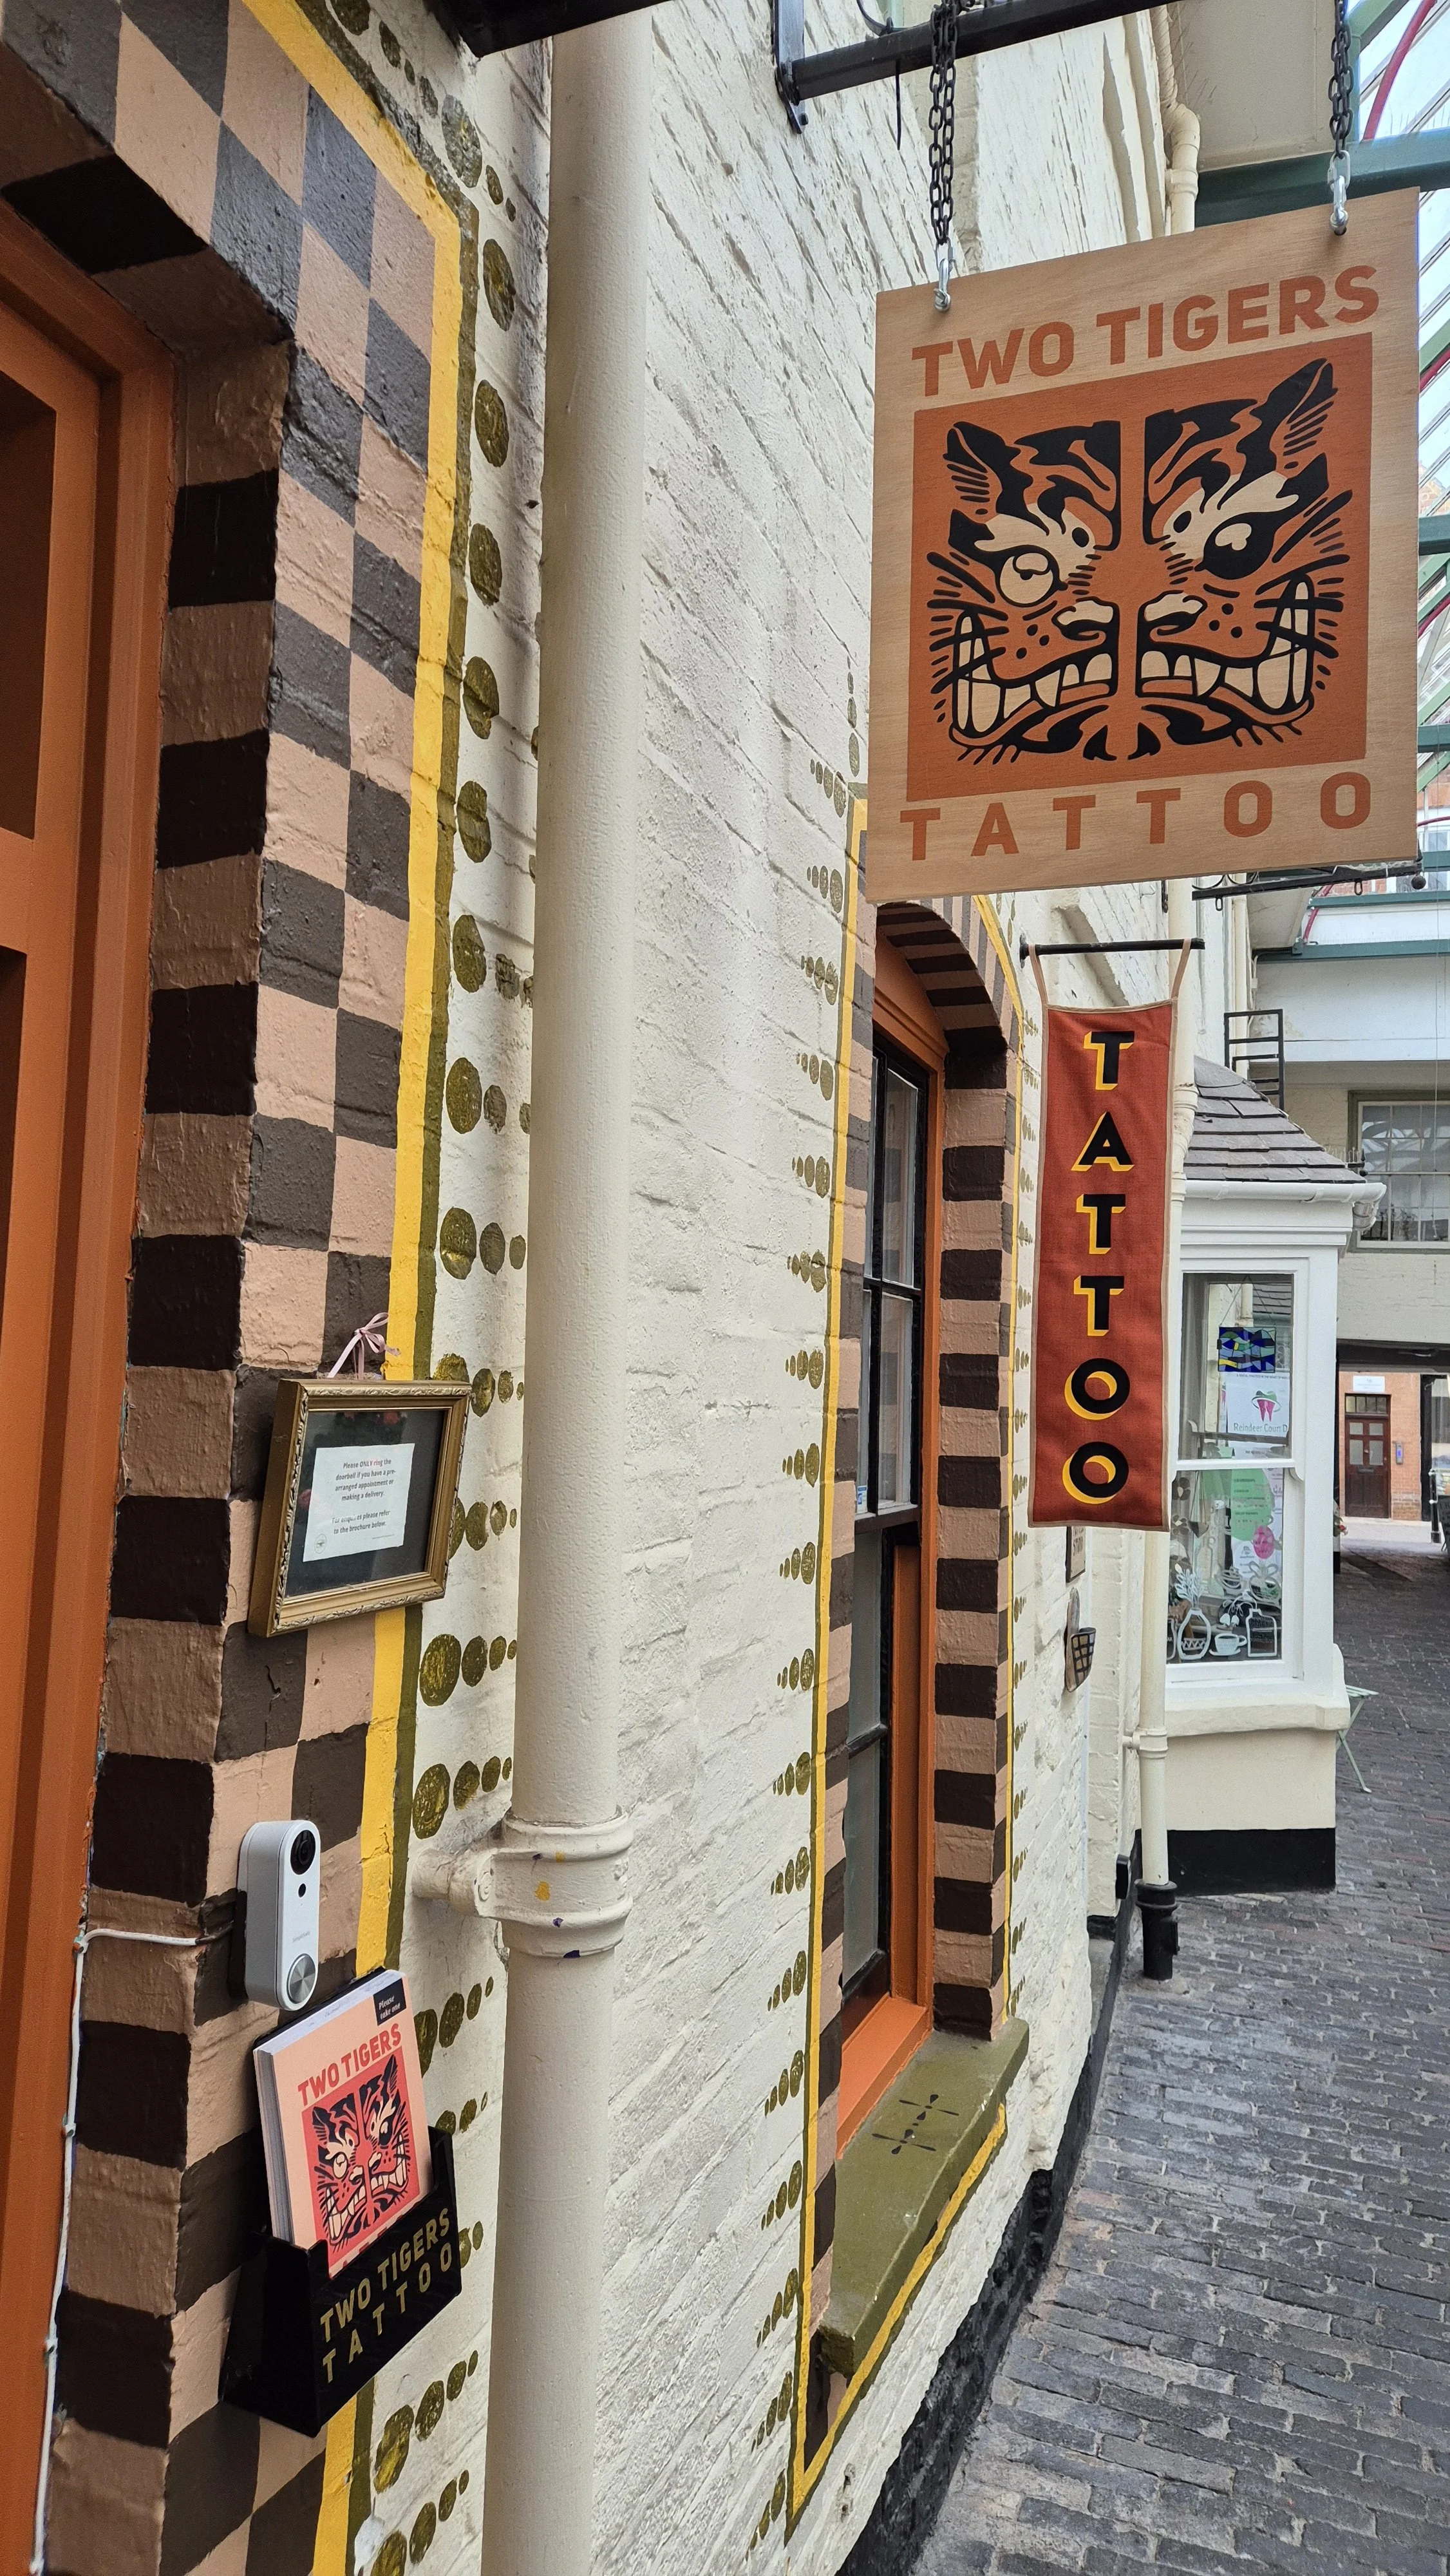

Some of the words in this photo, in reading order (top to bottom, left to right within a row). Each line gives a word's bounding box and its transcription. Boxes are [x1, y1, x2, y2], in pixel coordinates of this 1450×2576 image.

[912, 321, 1075, 397] TWO
[1097, 265, 1380, 365] TIGERS
[900, 771, 1371, 860] TATTOO
[1062, 1030, 1135, 1504] TATTOO
[1234, 1423, 1263, 1432] Reindeer
[1264, 1423, 1281, 1432] Court
[373, 1459, 383, 1467] ring
[335, 1472, 356, 1481] doorbell
[335, 1482, 358, 1492] arranged
[358, 1479, 388, 1490] appointment
[362, 1512, 378, 1521] please
[349, 1522, 370, 1532] brochure
[379, 1996, 395, 2010] Please
[380, 2009, 391, 2020] take
[391, 2003, 400, 2012] one
[297, 2063, 340, 2107] TWO
[341, 2023, 401, 2078] TIGERS
[320, 2278, 371, 2343] TWO
[377, 2208, 449, 2291] TIGERS
[323, 2242, 452, 2383] TATTOO
